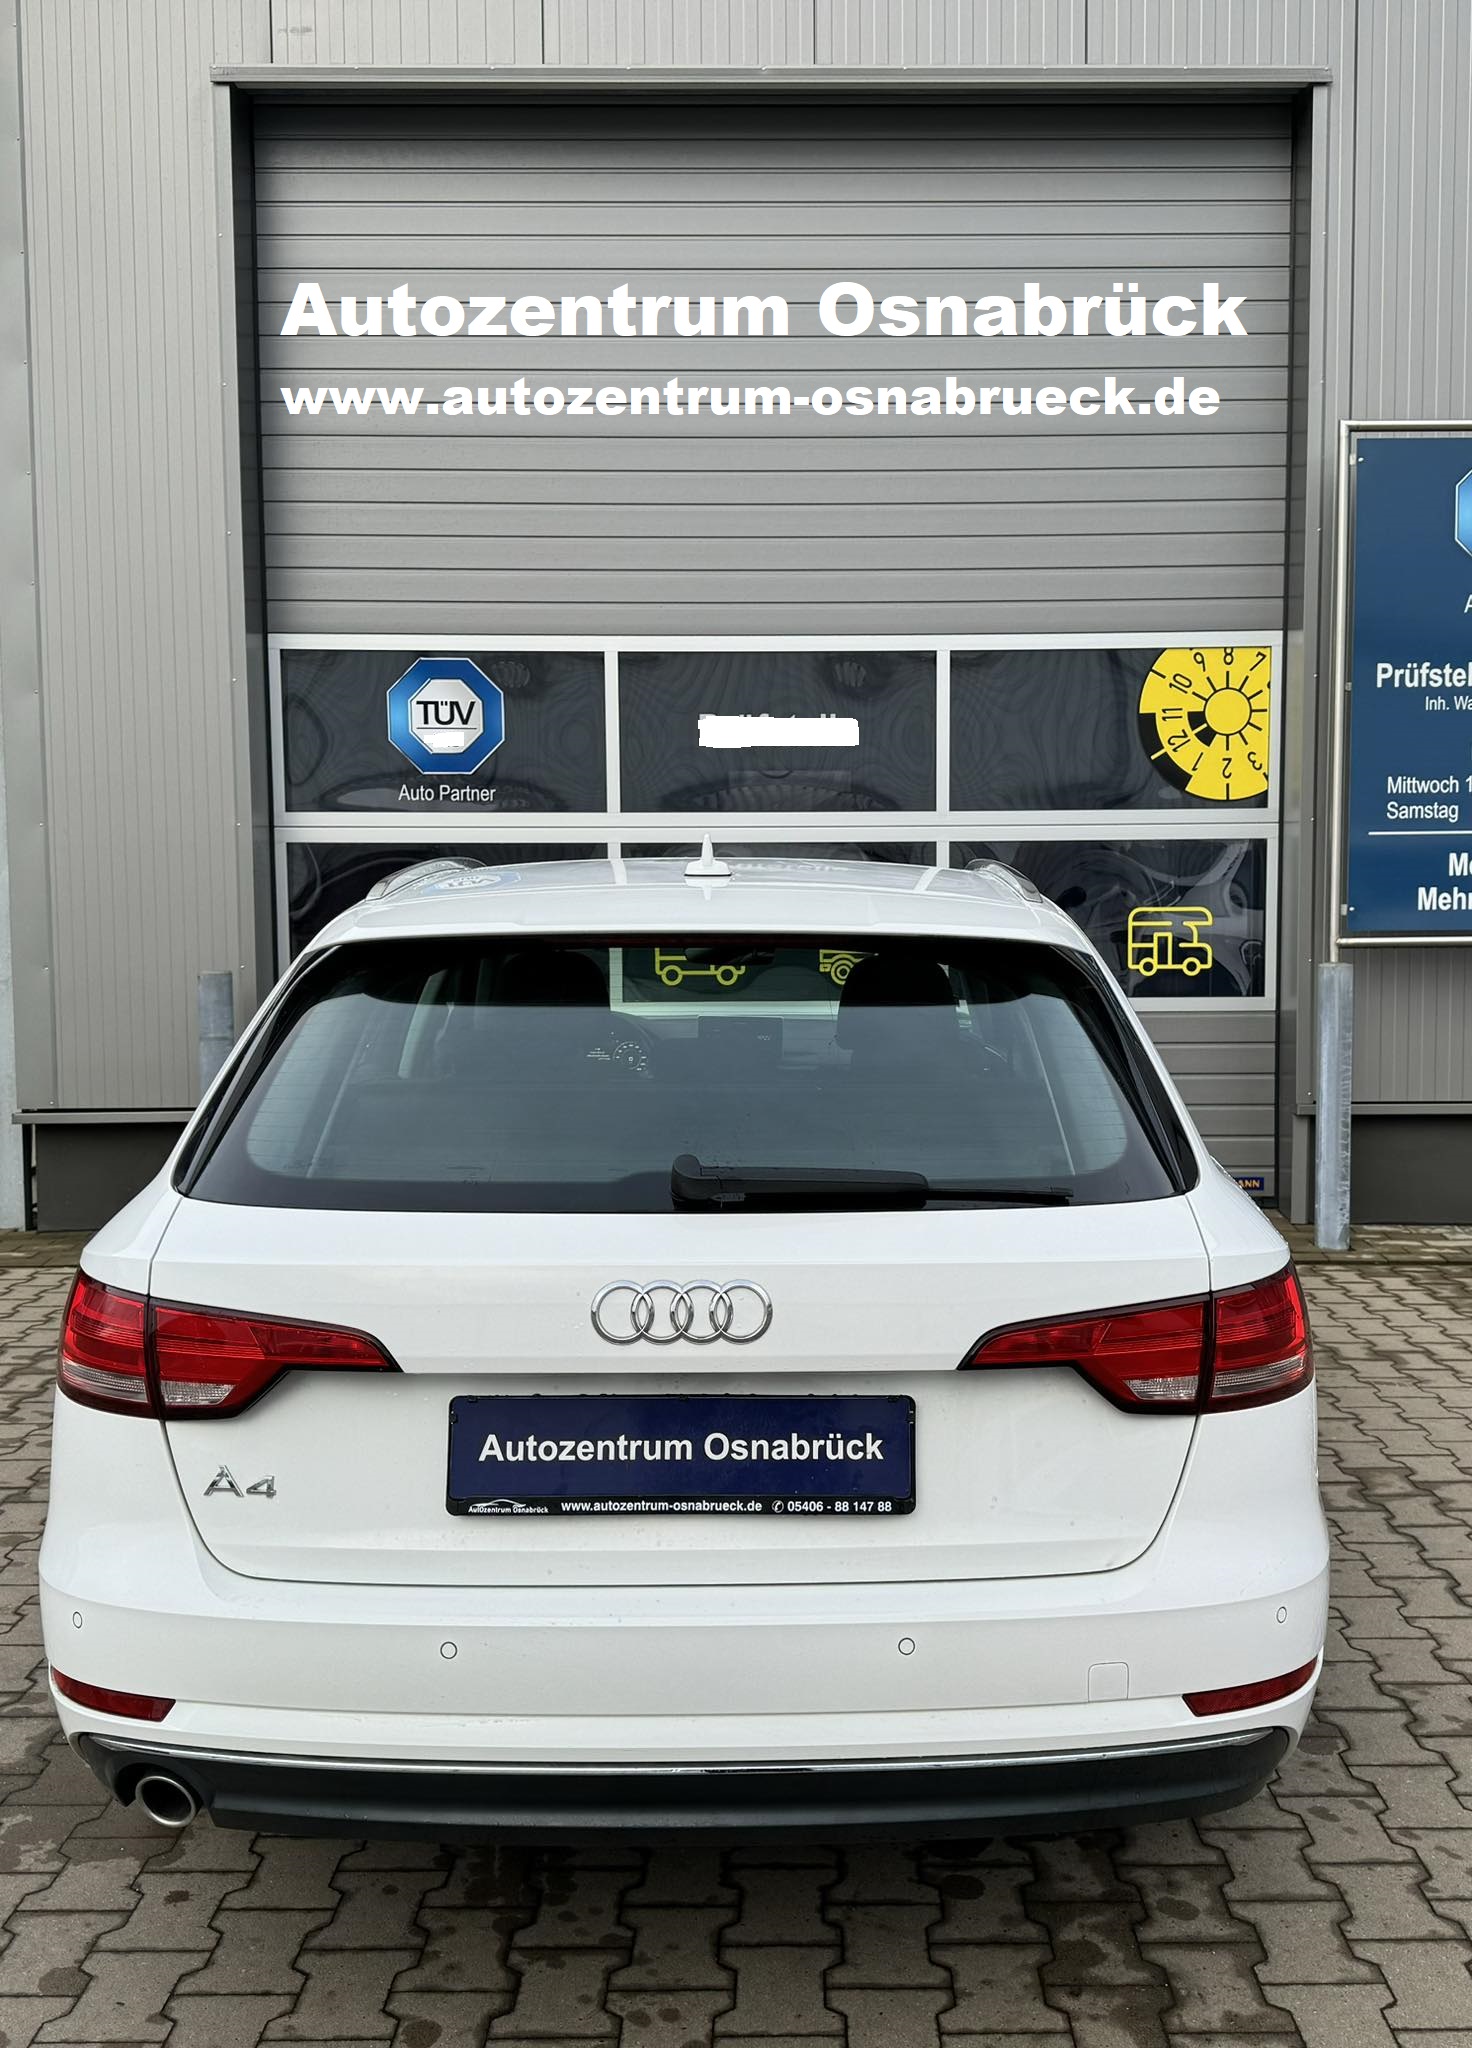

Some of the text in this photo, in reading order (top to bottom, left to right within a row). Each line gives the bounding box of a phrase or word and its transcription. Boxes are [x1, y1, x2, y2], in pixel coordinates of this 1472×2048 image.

[1193, 652, 1206, 672] 9
[1223, 647, 1234, 665] 8
[1249, 652, 1266, 671] 7
[1168, 673, 1192, 694] 10
[416, 700, 476, 726] TÜV
[1425, 695, 1450, 711] Inh.
[1161, 707, 1183, 721] 11
[1167, 729, 1191, 752] 12
[1221, 757, 1232, 779] 2
[1247, 751, 1263, 771] 3
[398, 784, 497, 801] Auto Partner
[1387, 775, 1459, 794] Mittwoch
[1386, 801, 1459, 823] Samstag
[478, 1432, 884, 1462] Autozentrum Osnabrück
[203, 1465, 276, 1498] A4
[560, 1499, 763, 1513] www.autozentrum-osnabrueck.de
[787, 1500, 824, 1512] 05406
[834, 1500, 850, 1512] 88
[853, 1500, 874, 1512] 147
[877, 1500, 892, 1512] 88
